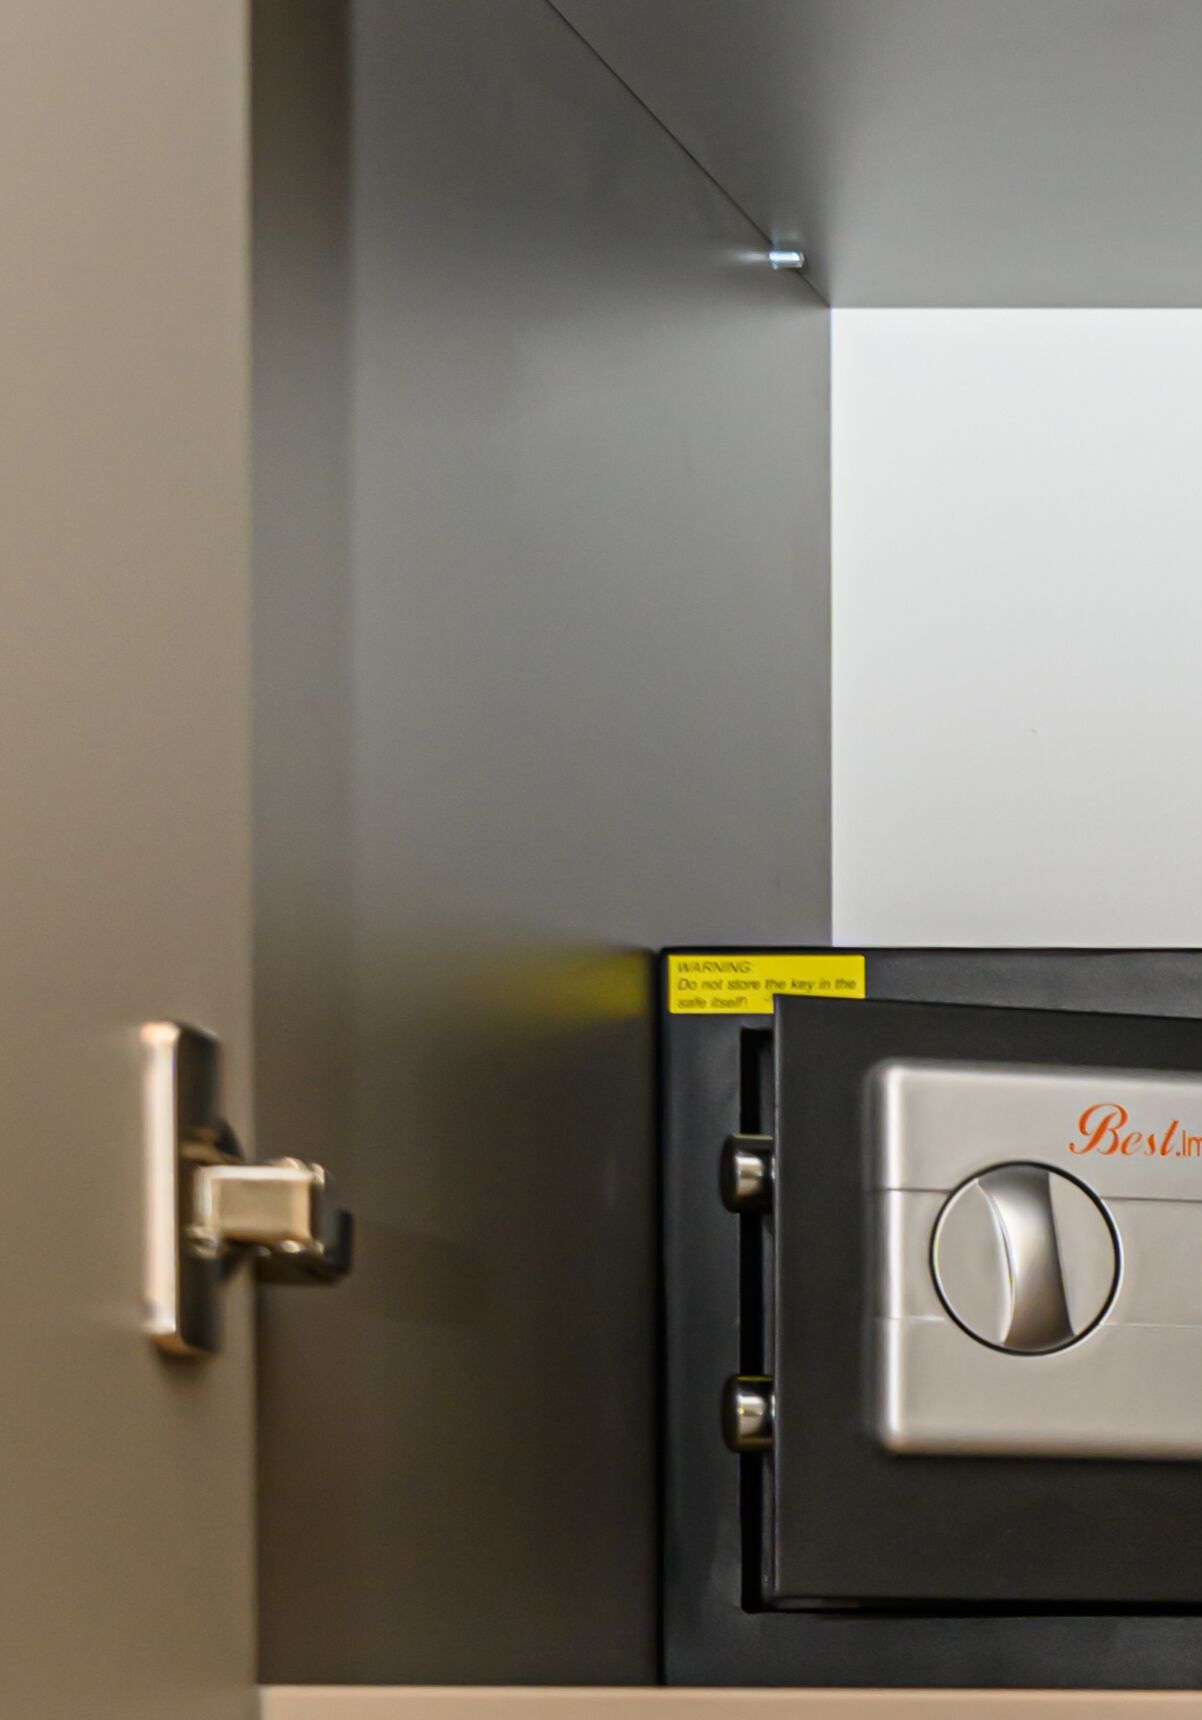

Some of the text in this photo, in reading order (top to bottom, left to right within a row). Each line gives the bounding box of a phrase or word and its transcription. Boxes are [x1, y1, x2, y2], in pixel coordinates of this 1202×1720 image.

[678, 978, 856, 993] Do not store the key in the
[678, 998, 707, 1009] safe
